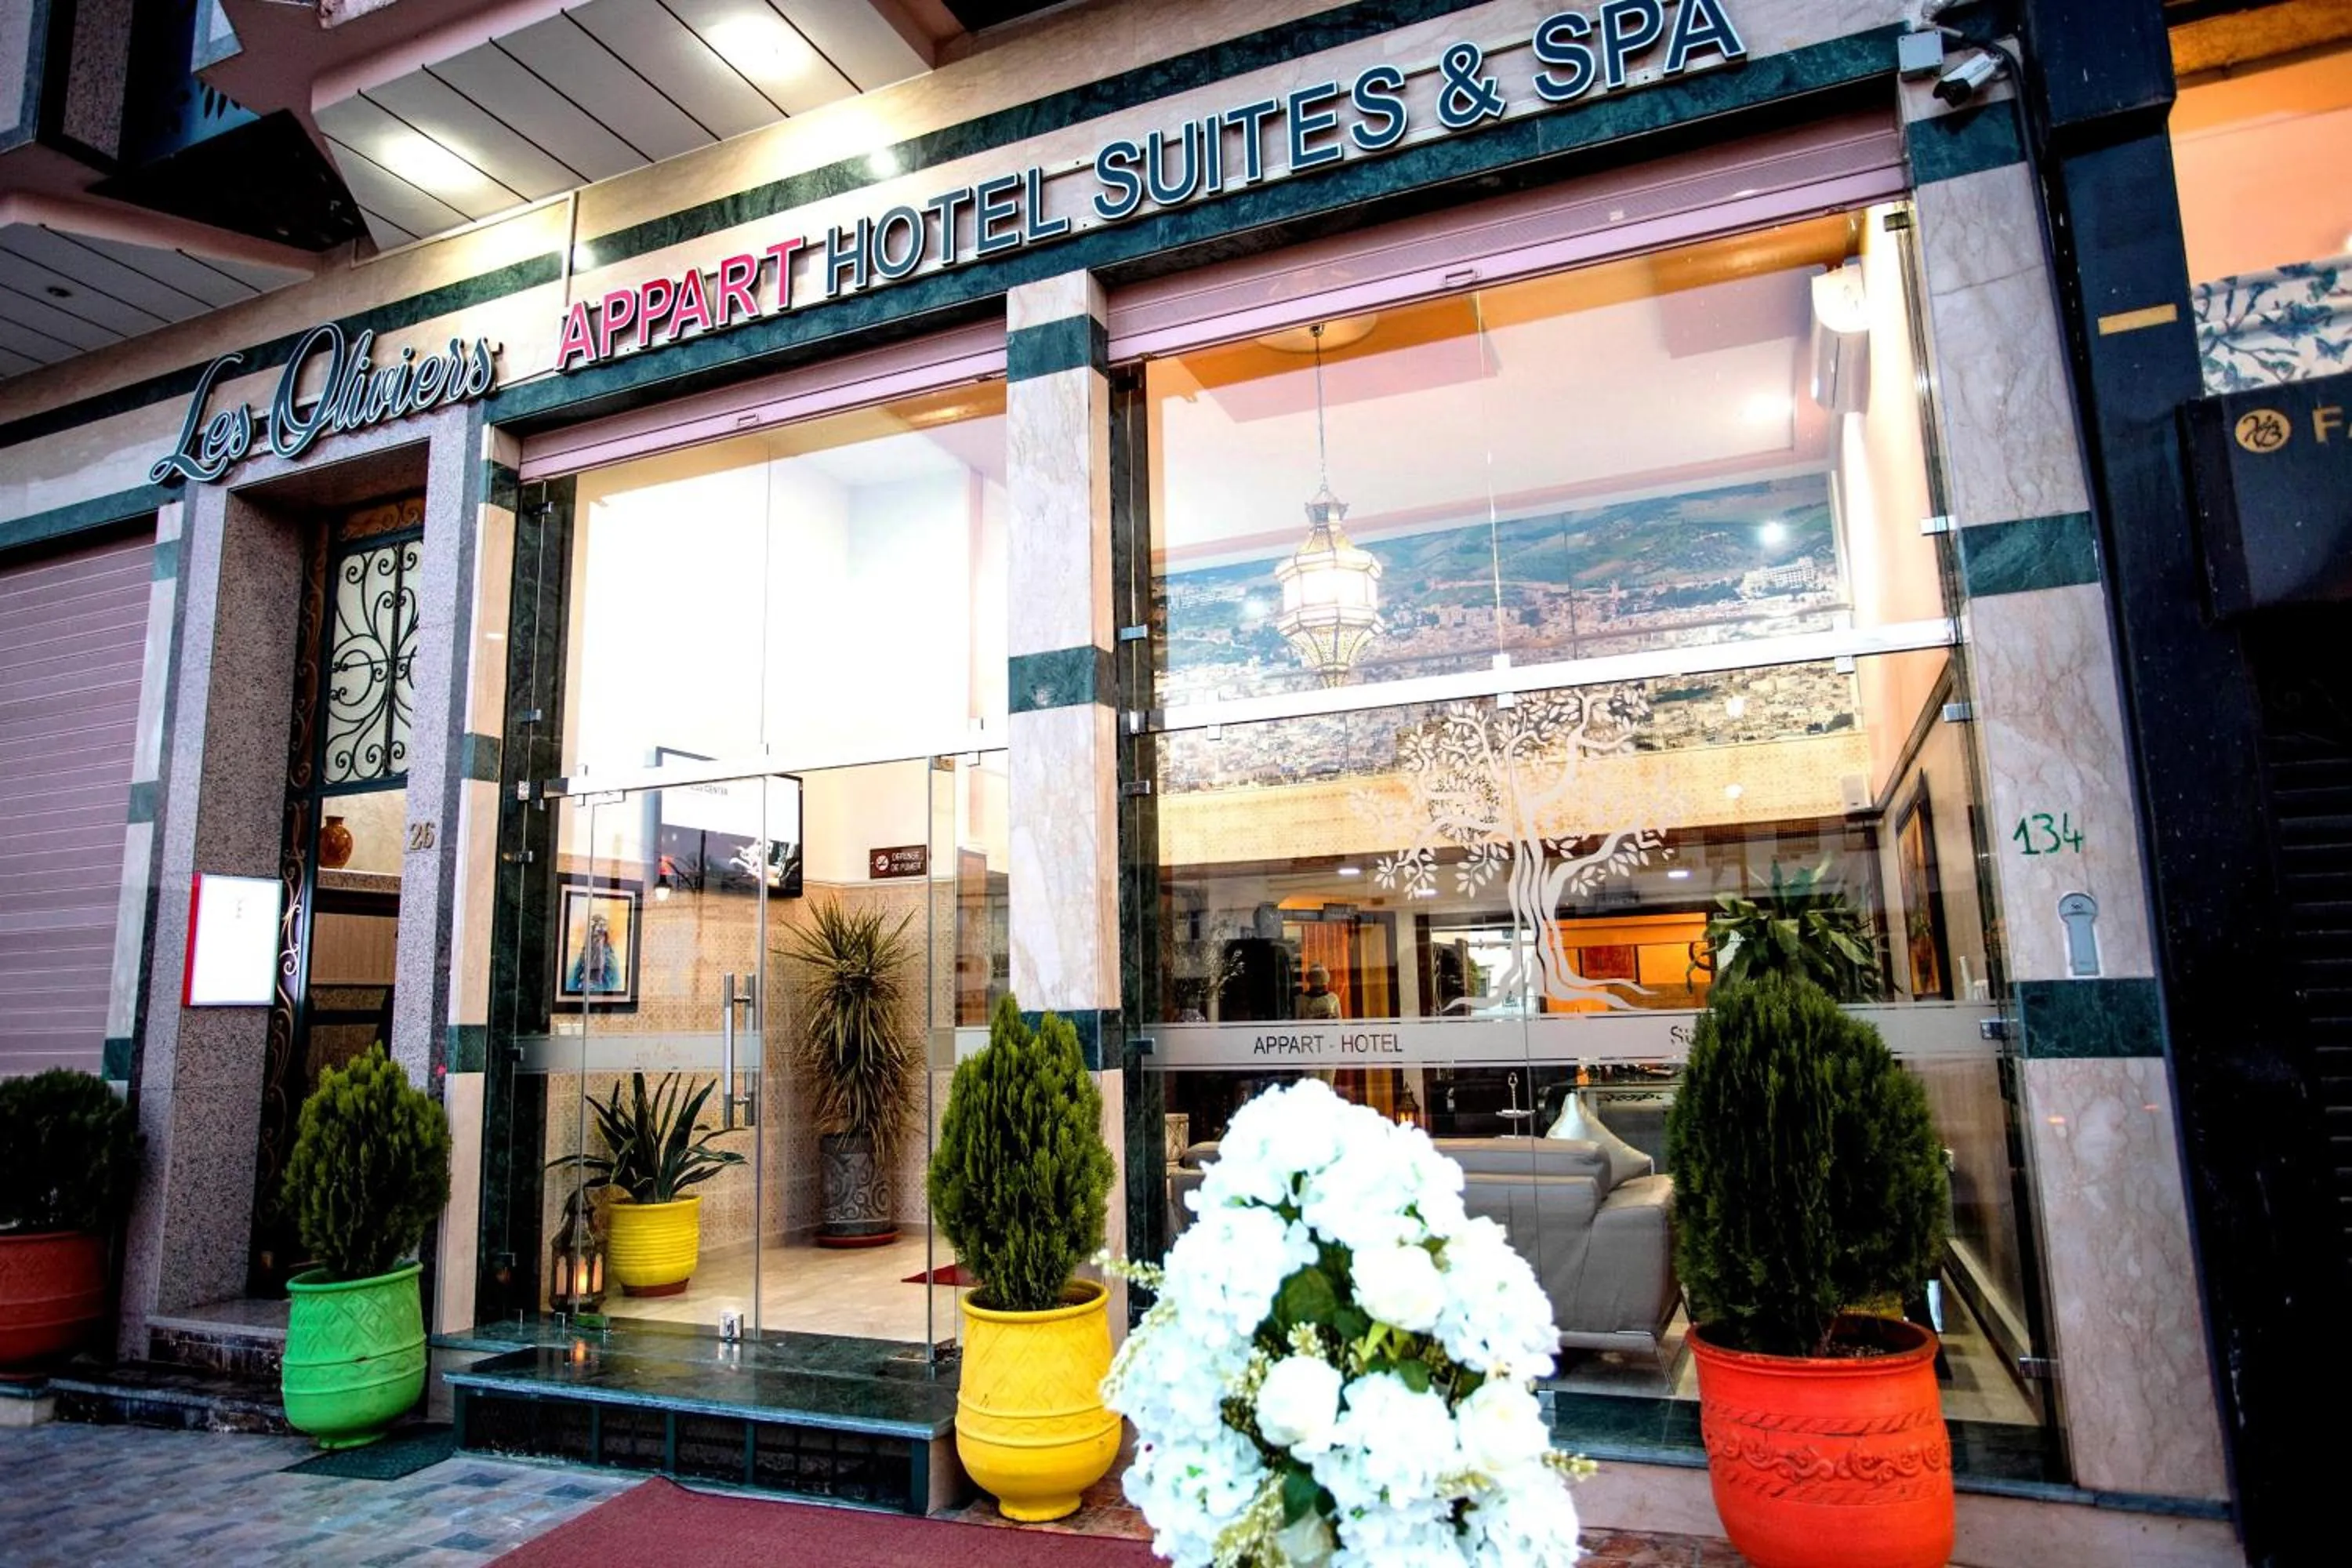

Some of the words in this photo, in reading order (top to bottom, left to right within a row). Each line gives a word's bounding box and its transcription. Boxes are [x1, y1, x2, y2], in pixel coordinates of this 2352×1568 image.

[555, 237, 804, 370] APPART
[826, 167, 1069, 296] HOTEL
[1093, 64, 1408, 220] SUITES
[1436, 42, 1506, 129] &
[1532, 0, 1746, 102] SPA
[150, 352, 255, 484] Les
[270, 322, 494, 460] Oliviers
[2312, 406, 2352, 444] F
[409, 822, 436, 851] 26
[2013, 811, 2084, 855] 134
[1254, 1035, 1324, 1054] APPART
[1341, 1033, 1403, 1053] HOTEL
